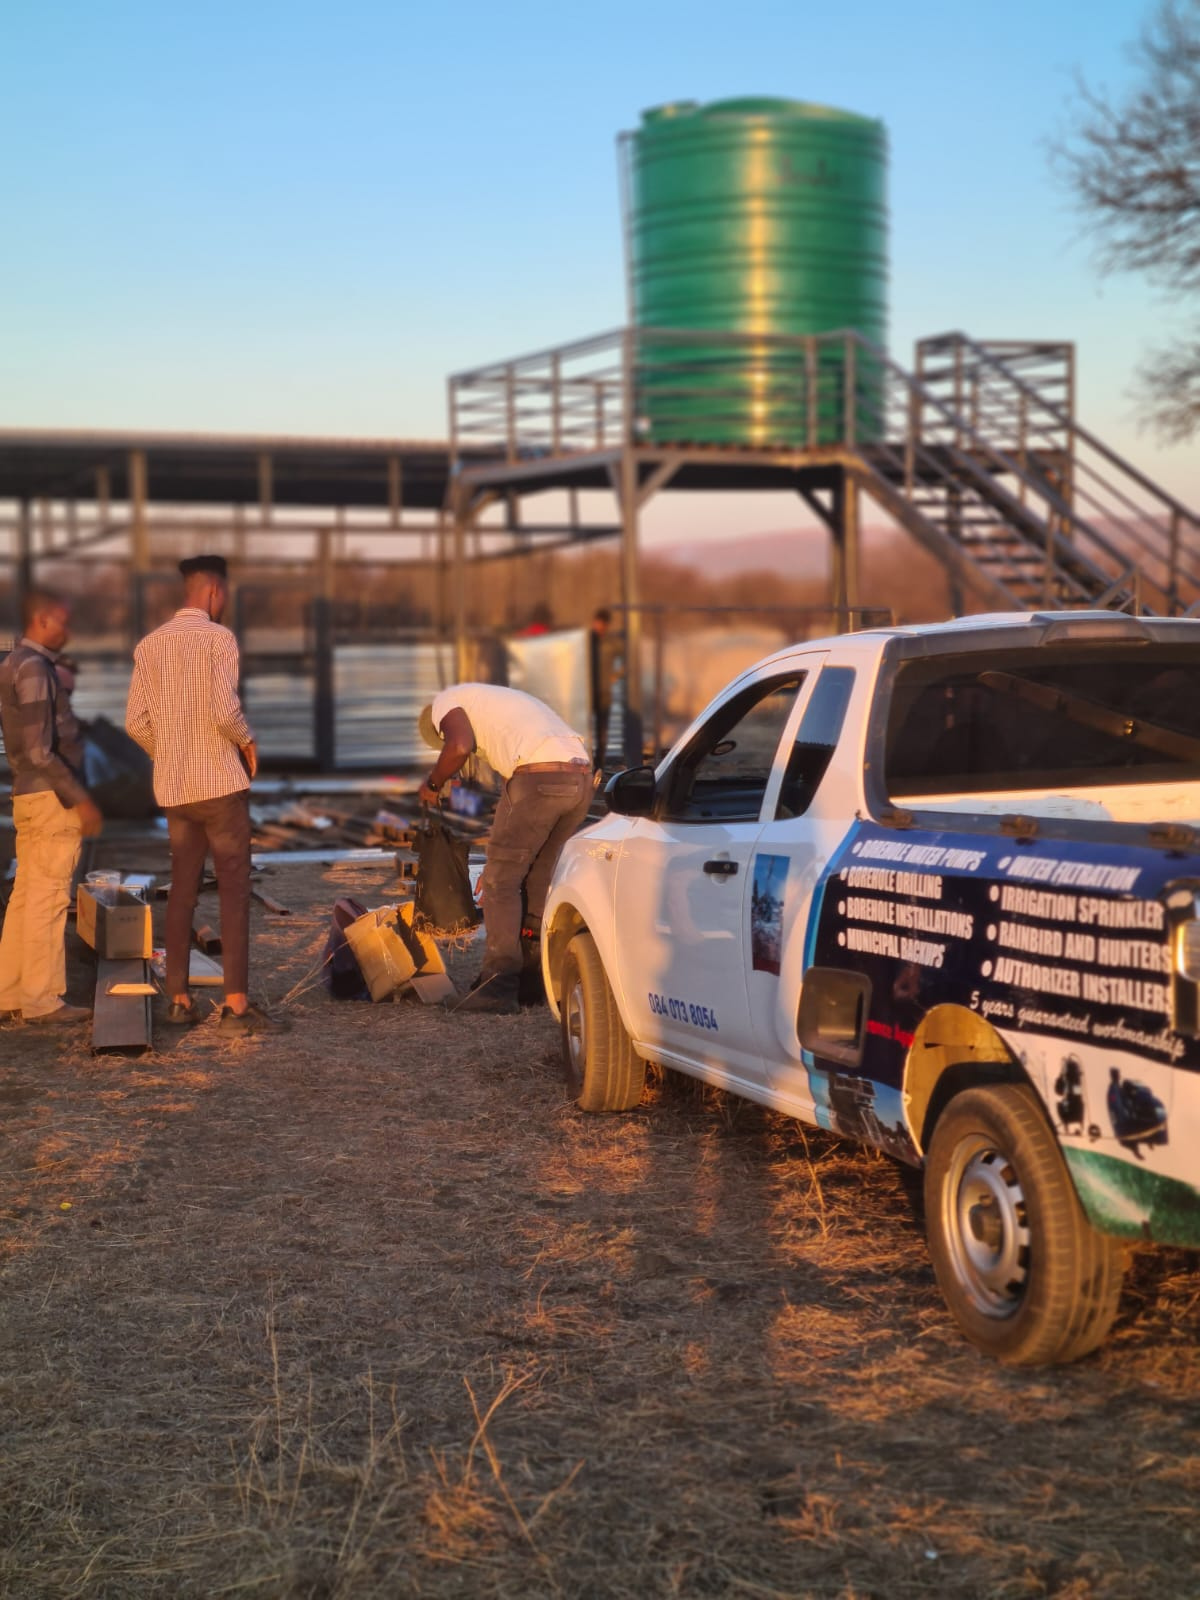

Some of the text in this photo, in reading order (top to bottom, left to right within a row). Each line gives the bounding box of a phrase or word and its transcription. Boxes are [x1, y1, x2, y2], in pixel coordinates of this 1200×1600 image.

[1001, 885, 1077, 921] IRRIGATION
[895, 903, 974, 940] INSTALLATIONS
[847, 928, 900, 958] MUNICIPAL
[998, 921, 1063, 957] RAINBIRD
[1064, 932, 1096, 963] AND
[648, 992, 719, 1031] 084 073 8054
[969, 990, 980, 1010] 5
[981, 1000, 1014, 1018] years
